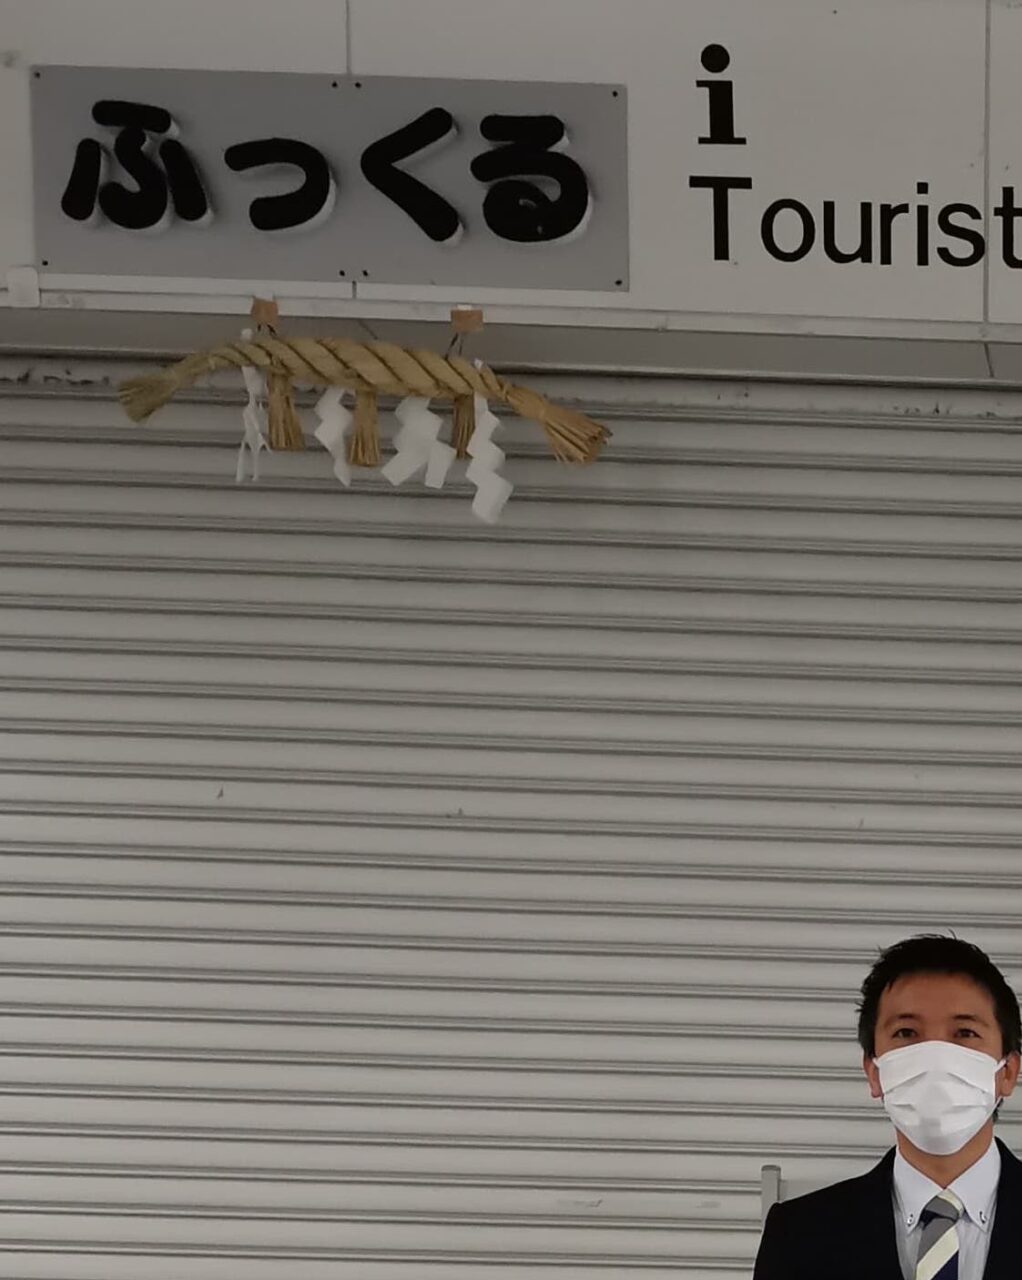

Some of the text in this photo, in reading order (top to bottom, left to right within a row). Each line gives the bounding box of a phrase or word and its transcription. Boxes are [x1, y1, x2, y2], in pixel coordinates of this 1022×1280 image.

[696, 44, 746, 144] i
[61, 100, 589, 242] ふっくる
